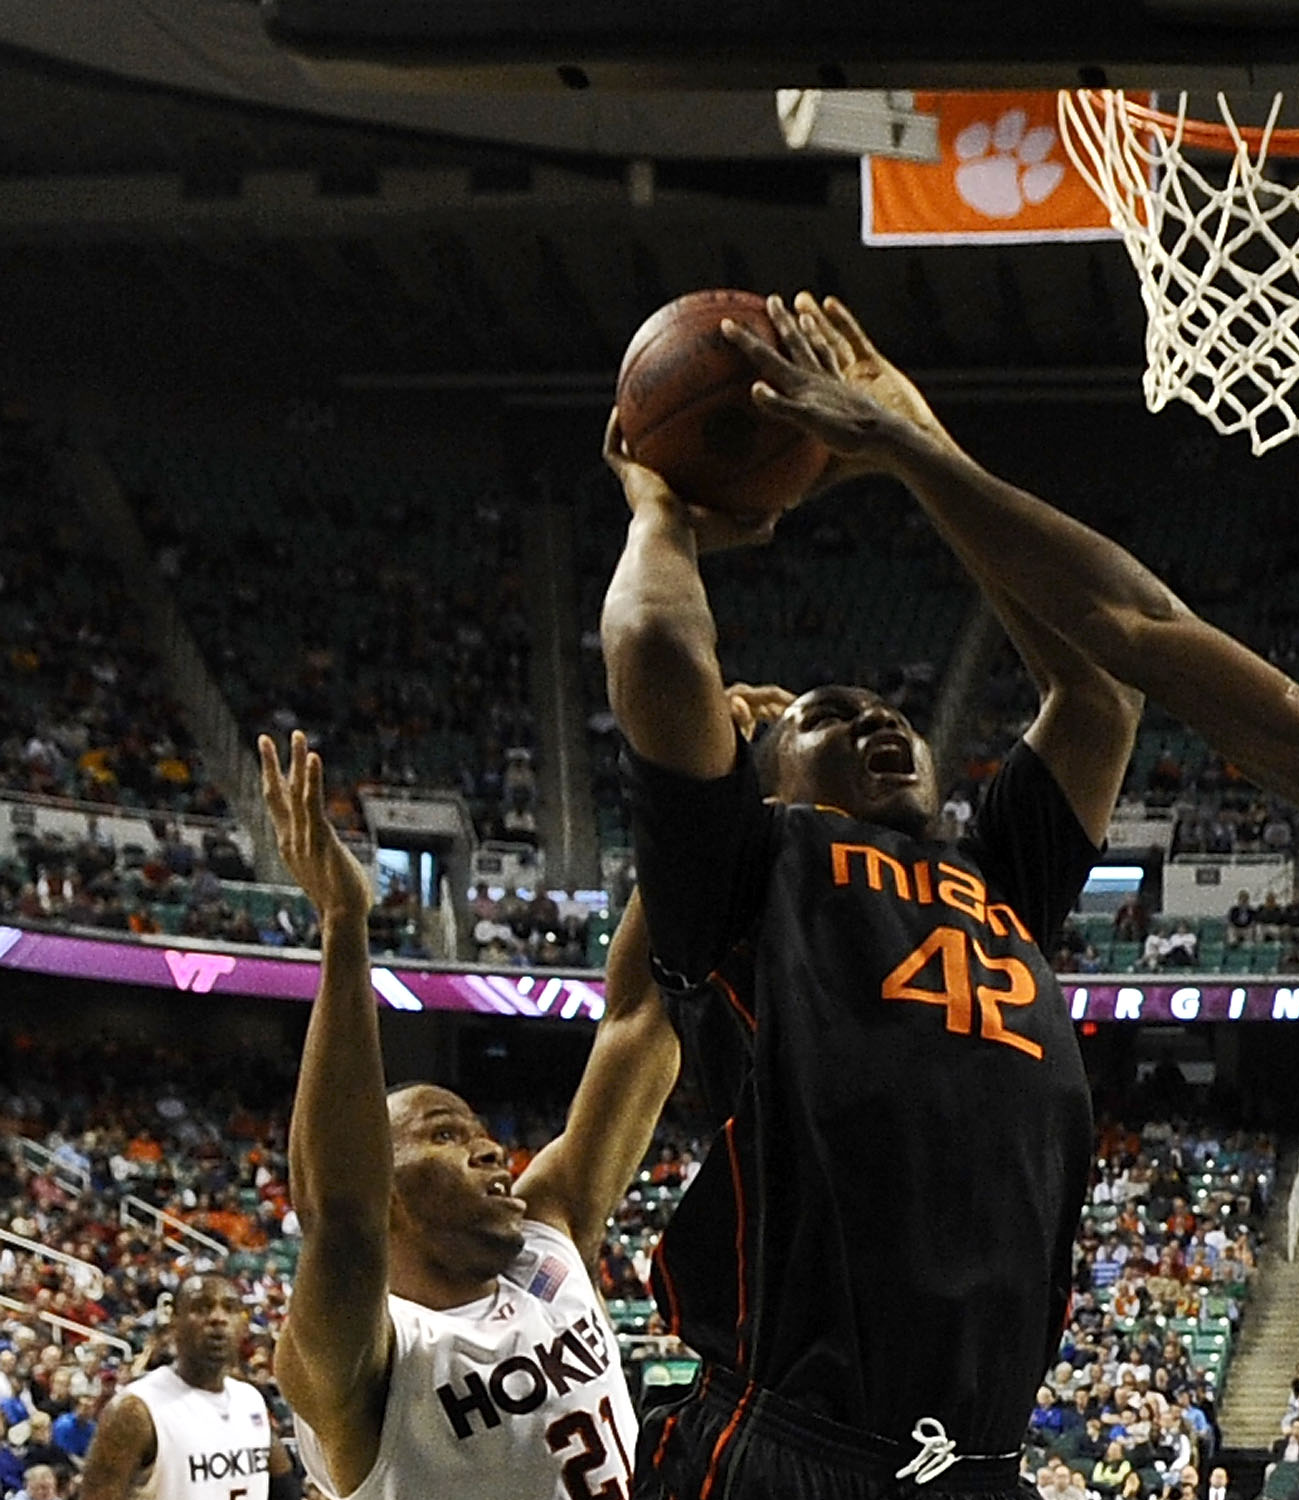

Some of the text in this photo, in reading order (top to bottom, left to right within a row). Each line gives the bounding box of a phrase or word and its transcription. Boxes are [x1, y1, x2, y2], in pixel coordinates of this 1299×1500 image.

[882, 926, 1043, 1060] 42
[436, 1308, 611, 1440] HOKIE
[188, 1447, 271, 1483] HOKIE
